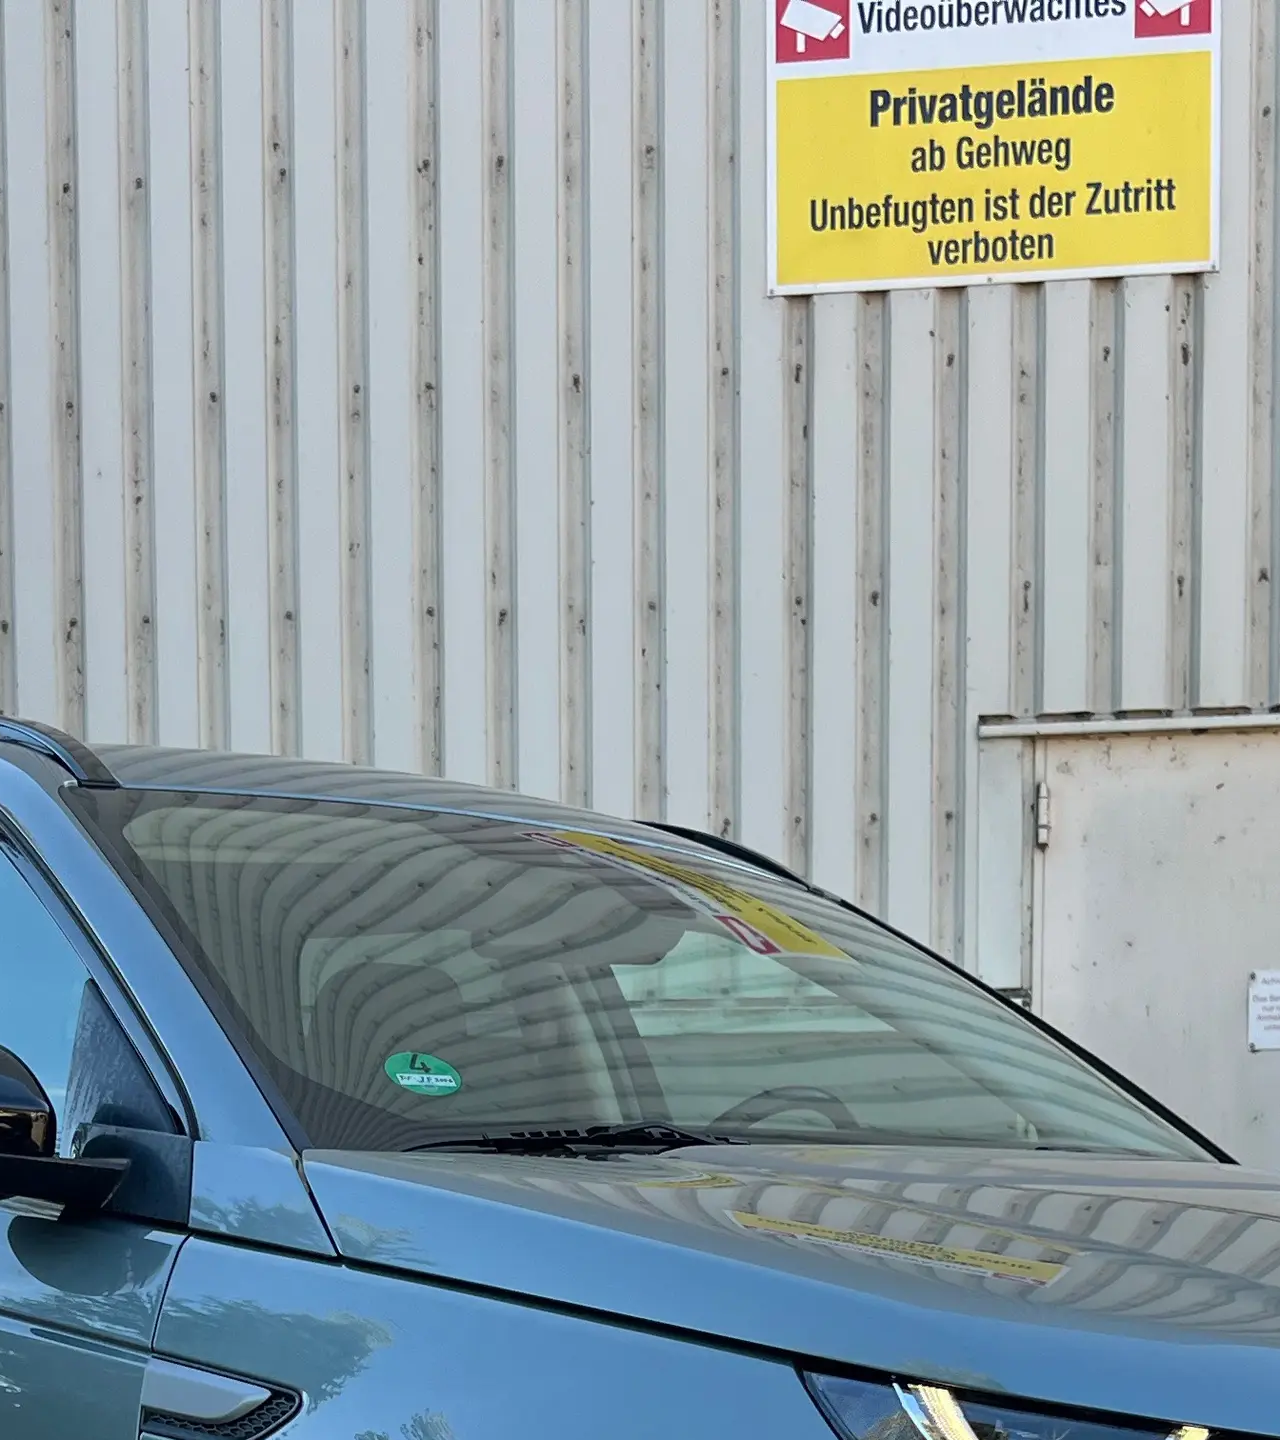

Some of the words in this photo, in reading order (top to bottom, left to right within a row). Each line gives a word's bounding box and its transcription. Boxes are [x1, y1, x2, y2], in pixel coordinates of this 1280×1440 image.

[857, 0, 1127, 34] Videoüberwachtes
[869, 76, 1115, 129] Privatgelände
[911, 139, 946, 172] ab
[956, 135, 1072, 171] Gehweg
[810, 193, 974, 233] Unbefugten
[984, 187, 1020, 221] ist
[1029, 186, 1076, 219] der
[1086, 179, 1176, 215] Zutritt
[928, 231, 1054, 266] verboten
[409, 1053, 432, 1073] 4
